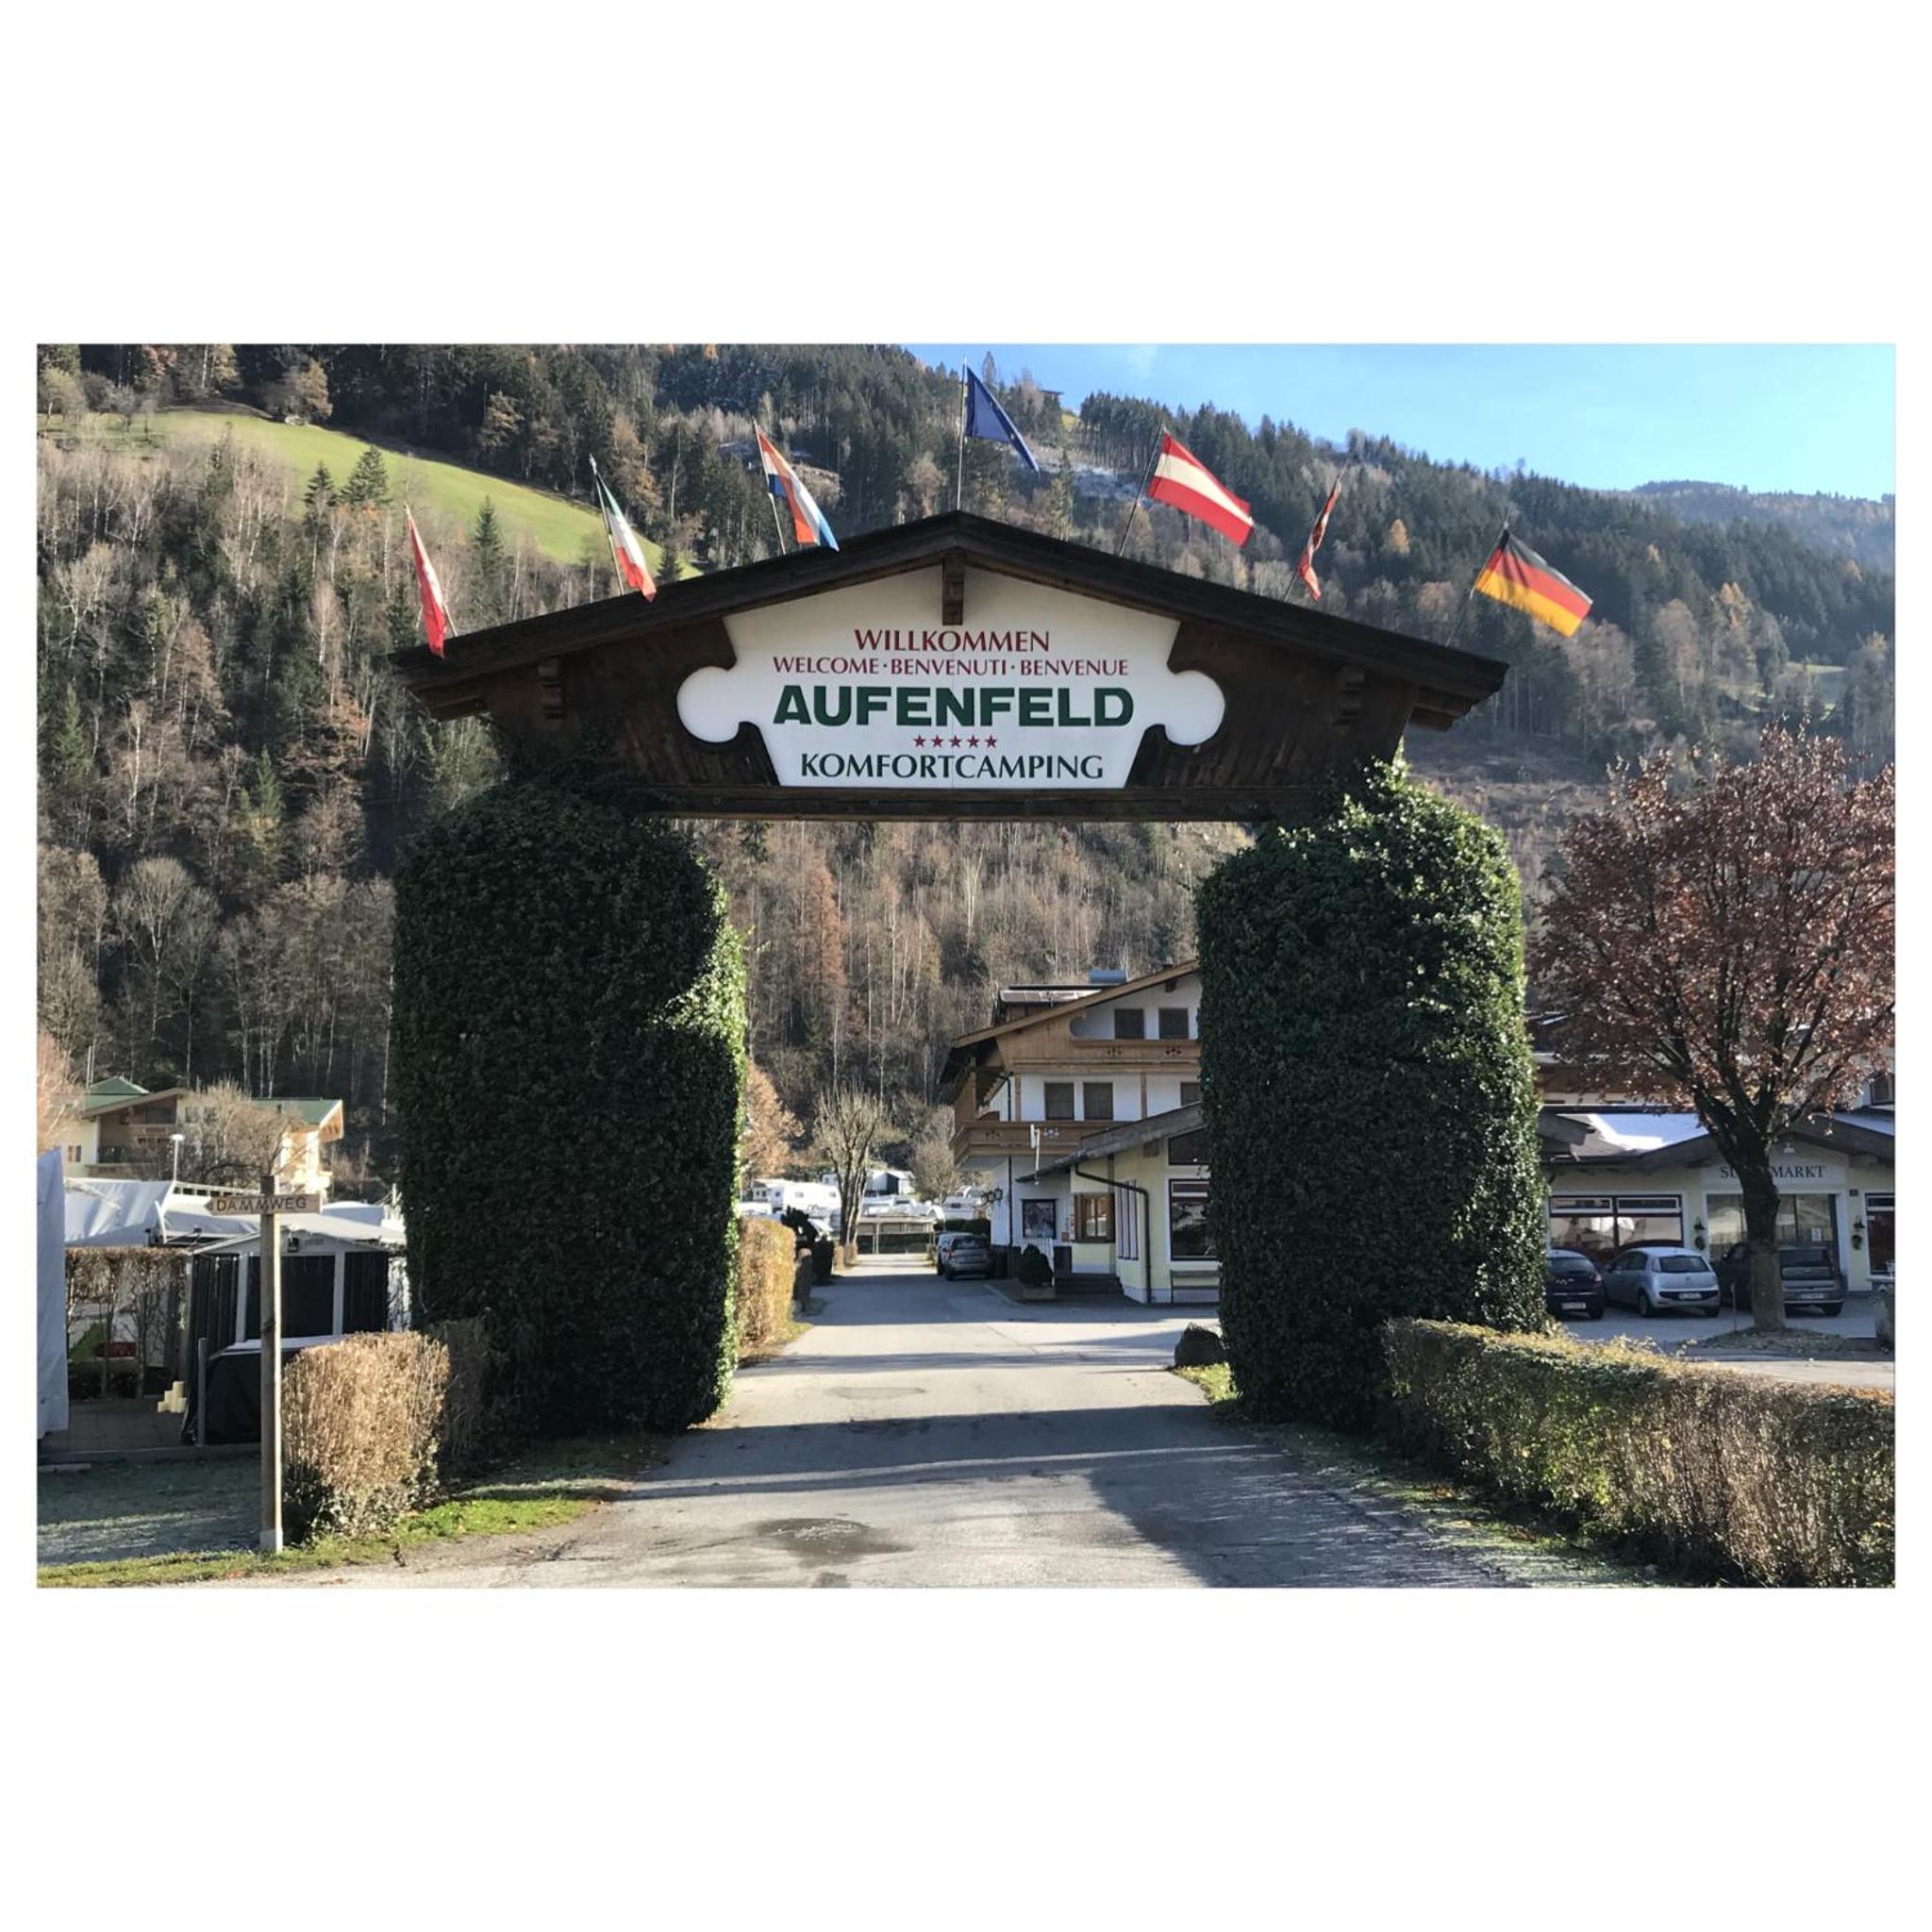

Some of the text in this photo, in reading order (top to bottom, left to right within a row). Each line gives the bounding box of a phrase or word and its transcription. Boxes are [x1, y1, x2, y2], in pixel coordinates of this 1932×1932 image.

[855, 629, 1049, 653] WILLKOMMEN
[774, 685, 1134, 727] AUFENFELD
[801, 753, 1104, 779] KOMFORTCAMPING
[217, 1196, 307, 1212] DAMMWEG
